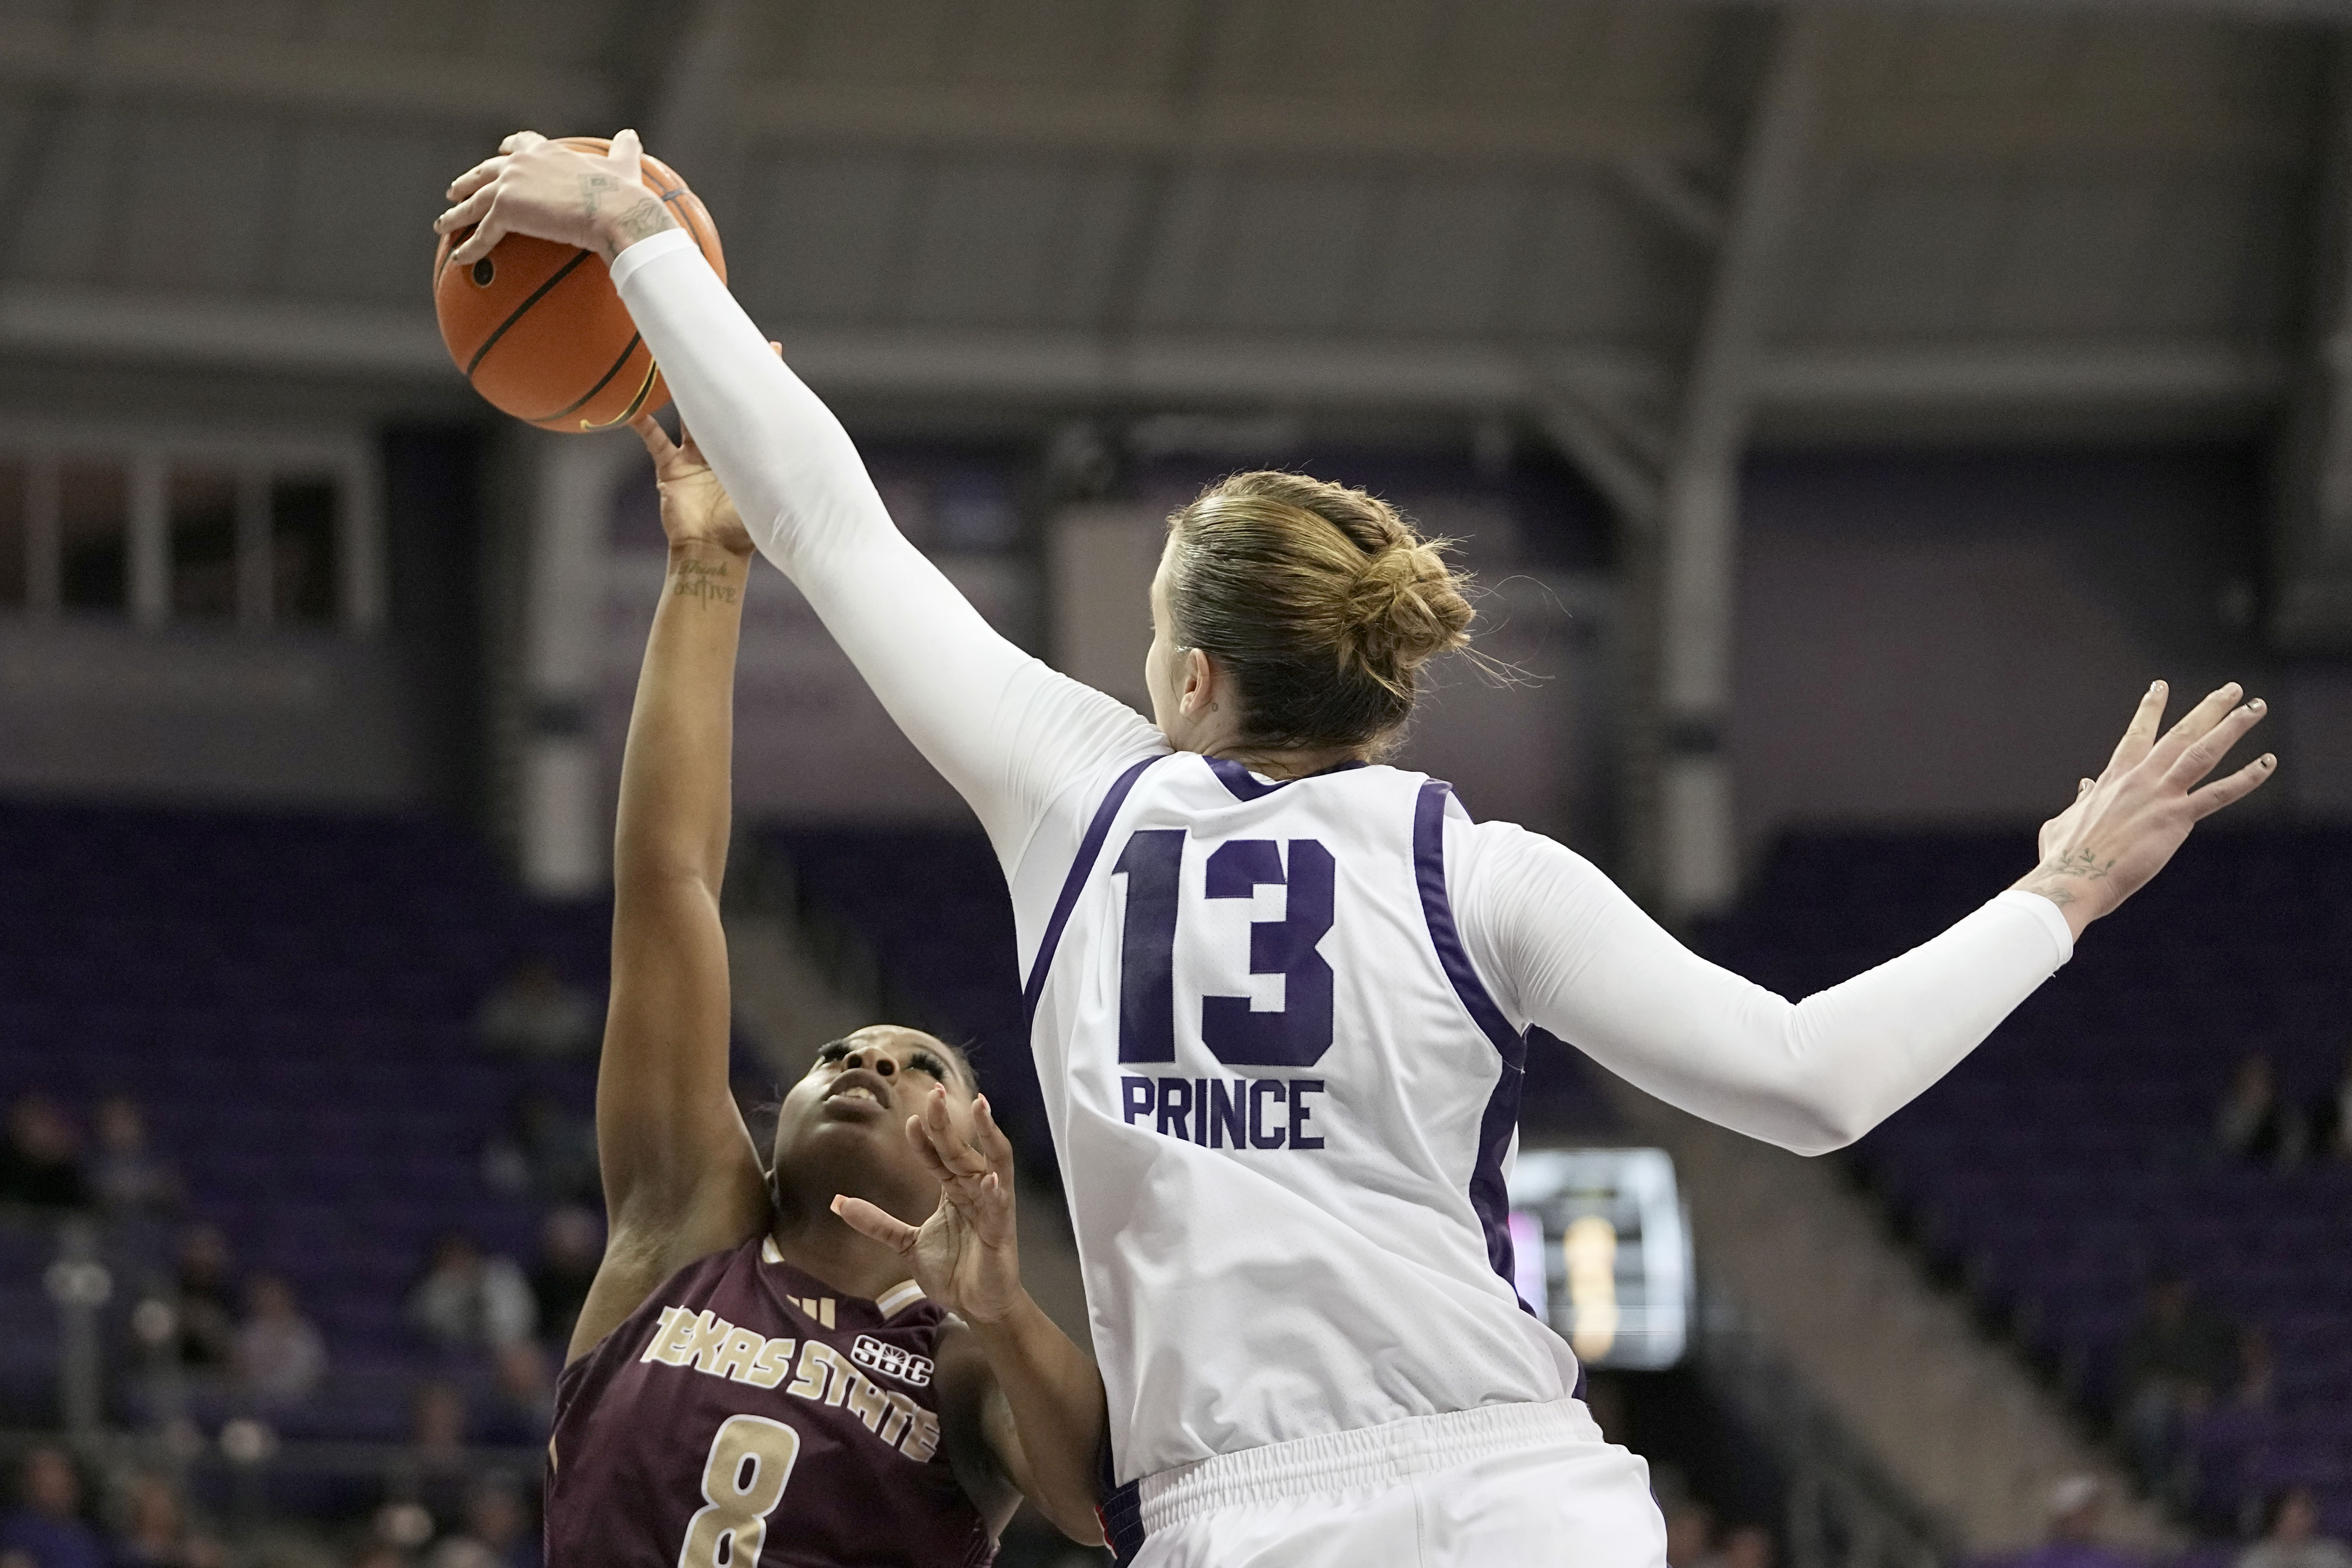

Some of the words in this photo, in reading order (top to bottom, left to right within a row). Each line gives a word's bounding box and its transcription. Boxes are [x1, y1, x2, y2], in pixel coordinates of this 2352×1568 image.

[673, 575, 736, 611] OSITIVE
[1111, 829, 1336, 1067] 13
[1121, 1076, 1325, 1150] PRINCE
[640, 1305, 796, 1389] TEXAS
[786, 1340, 940, 1463] STATE
[850, 1334, 935, 1387] SBC
[678, 1413, 800, 1568] 8
